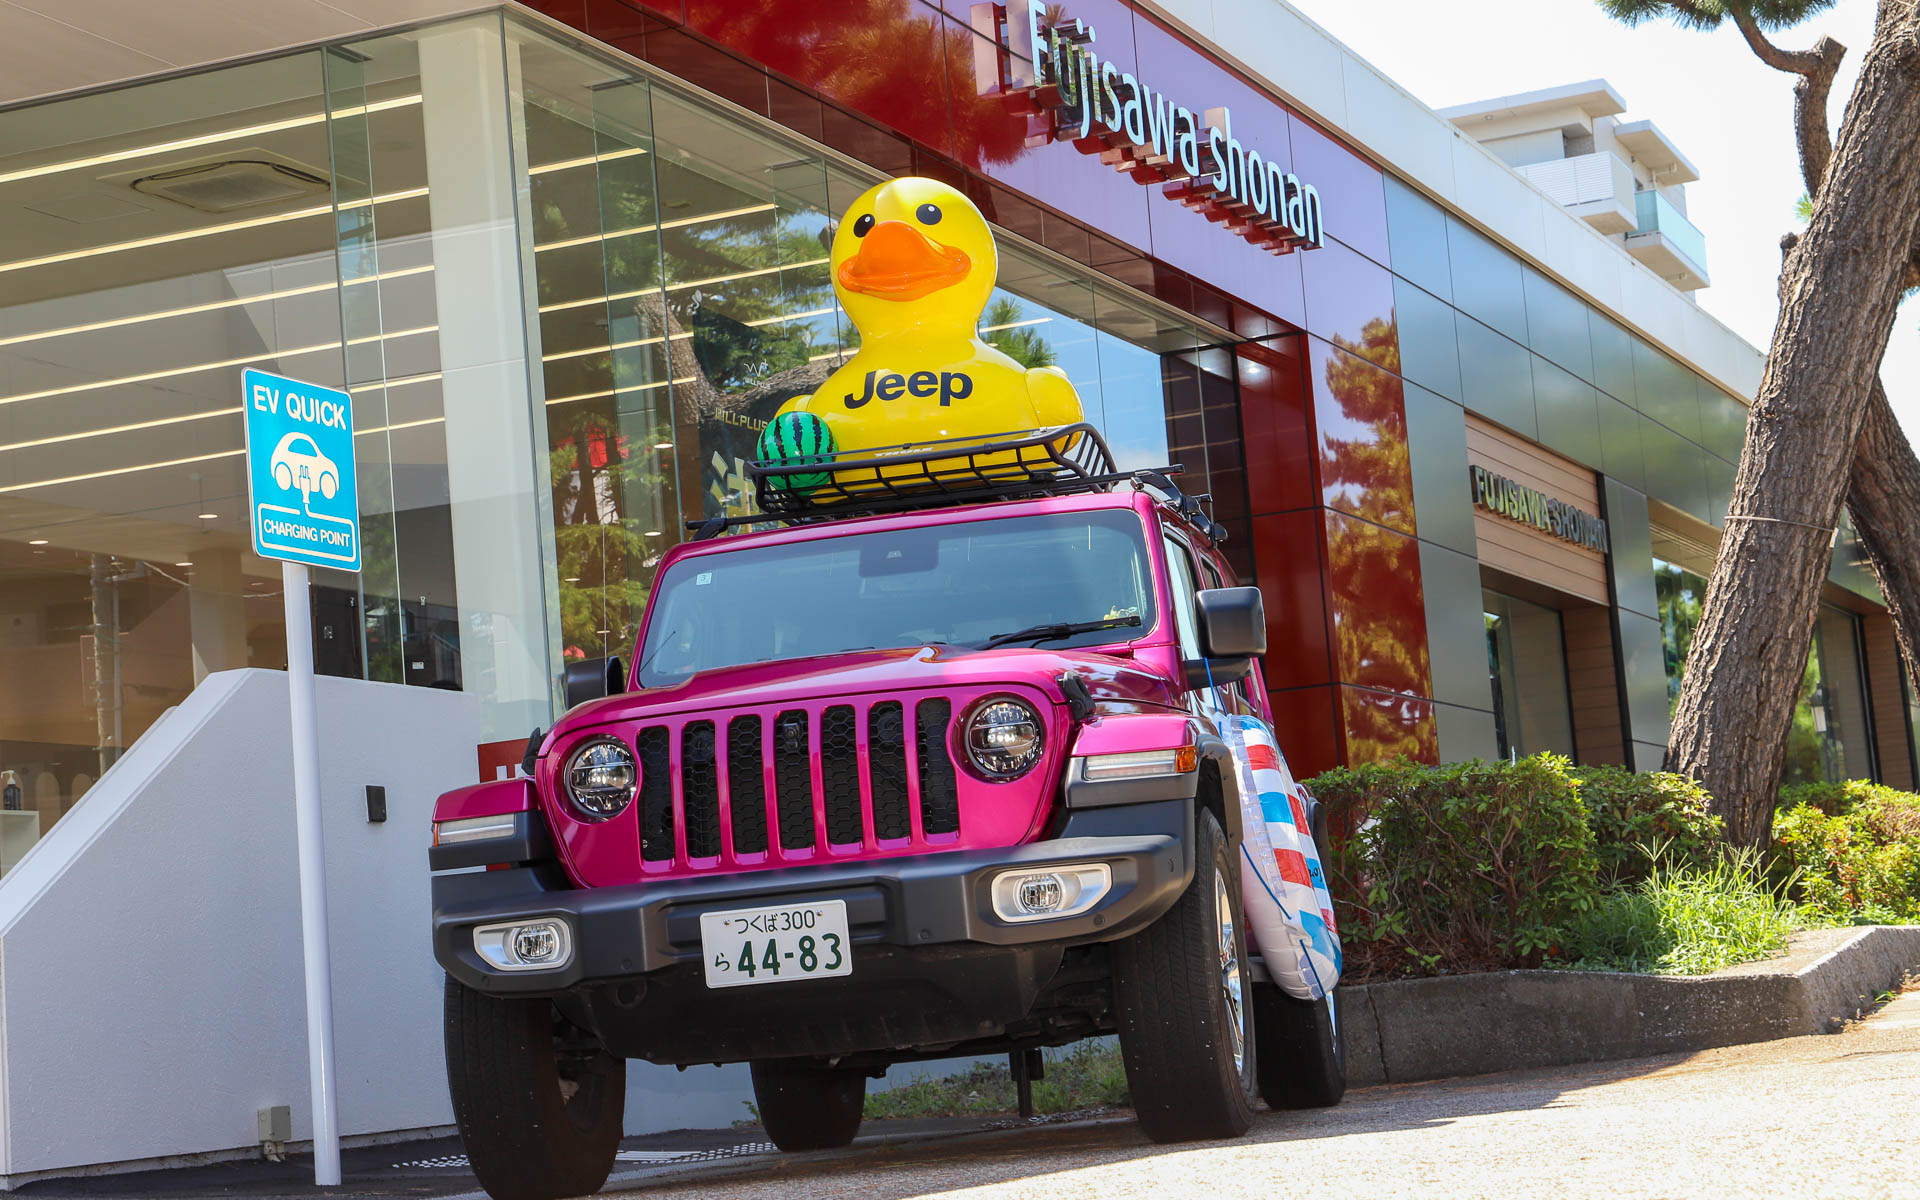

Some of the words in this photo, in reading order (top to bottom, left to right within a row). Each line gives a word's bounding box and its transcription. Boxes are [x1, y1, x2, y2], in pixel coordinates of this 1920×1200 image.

[1028, 0, 1199, 177] Fujisawa
[1210, 106, 1325, 249] shonan
[253, 384, 280, 414] EV
[286, 393, 347, 430] QUICK
[844, 370, 973, 409] Jeep
[263, 519, 319, 541] CHARGING
[320, 529, 350, 547] POINT
[714, 952, 731, 972] ら
[737, 932, 843, 978] 44-83
